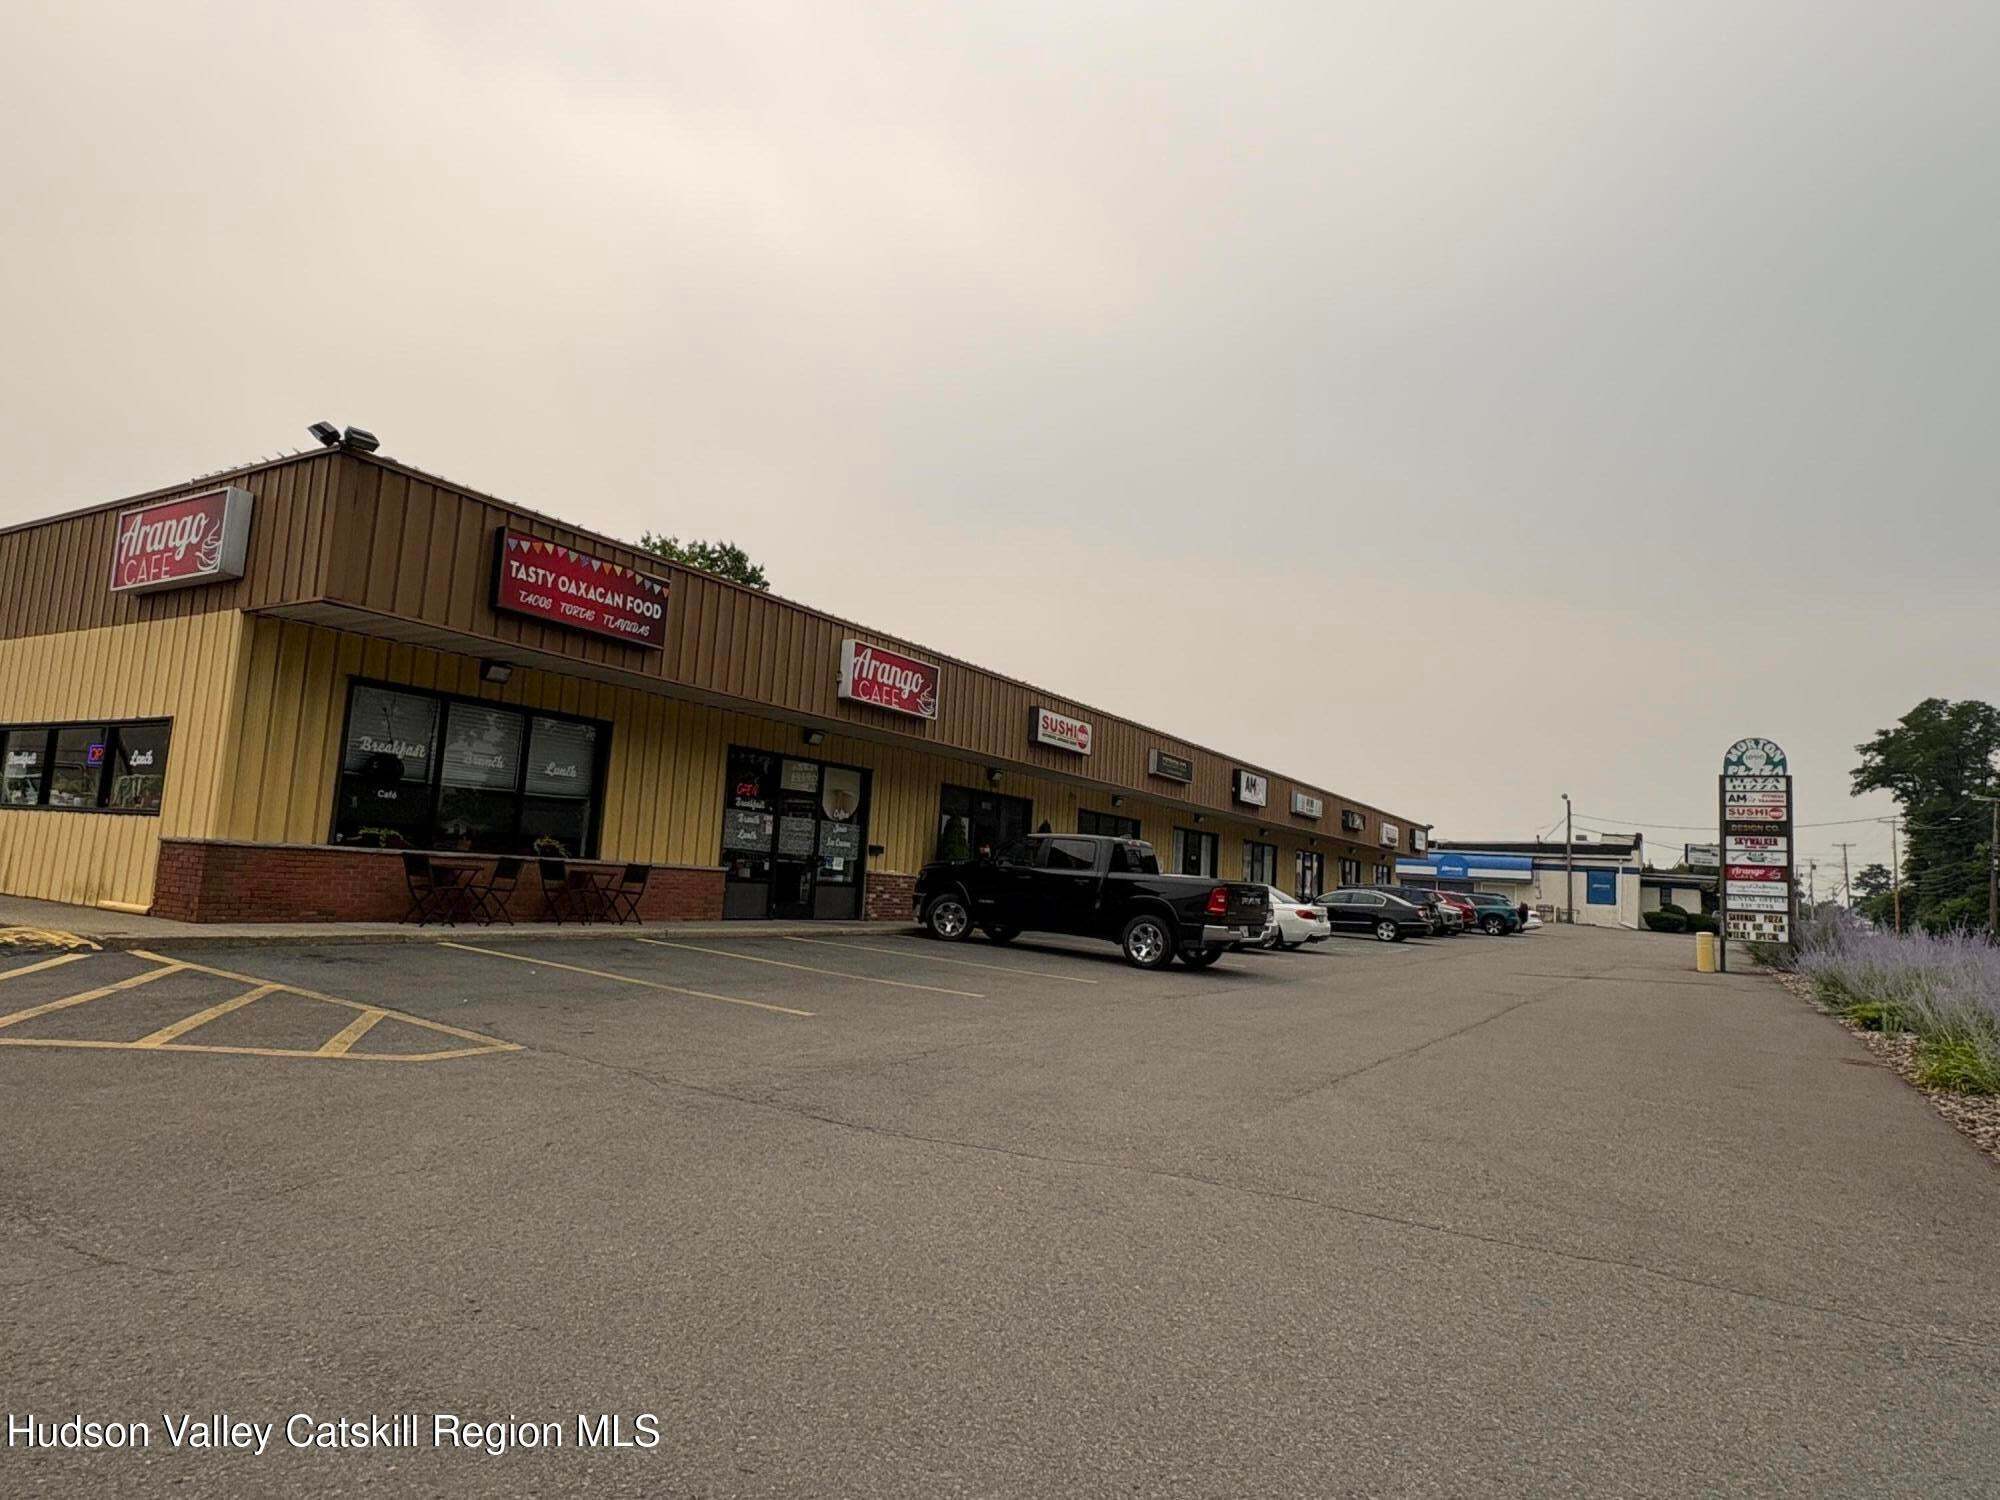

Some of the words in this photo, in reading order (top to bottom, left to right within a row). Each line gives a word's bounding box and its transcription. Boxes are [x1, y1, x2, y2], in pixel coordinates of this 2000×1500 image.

[121, 513, 209, 564] Arango
[124, 552, 173, 585] CAFE
[510, 560, 556, 588] TASTY
[558, 576, 623, 608] OAXACAN
[626, 595, 662, 619] FOOD
[519, 590, 552, 610] TACOS
[560, 602, 596, 622] TORTAS
[854, 648, 924, 699] Arango
[859, 680, 900, 708] CAFE
[1042, 715, 1077, 738] SUSHI
[91, 748, 104, 760] OP
[359, 736, 425, 760] Breakfast
[545, 763, 577, 777] Lunch
[1728, 808, 1768, 816] SUSHI
[1734, 838, 1778, 846] SKYWALKER
